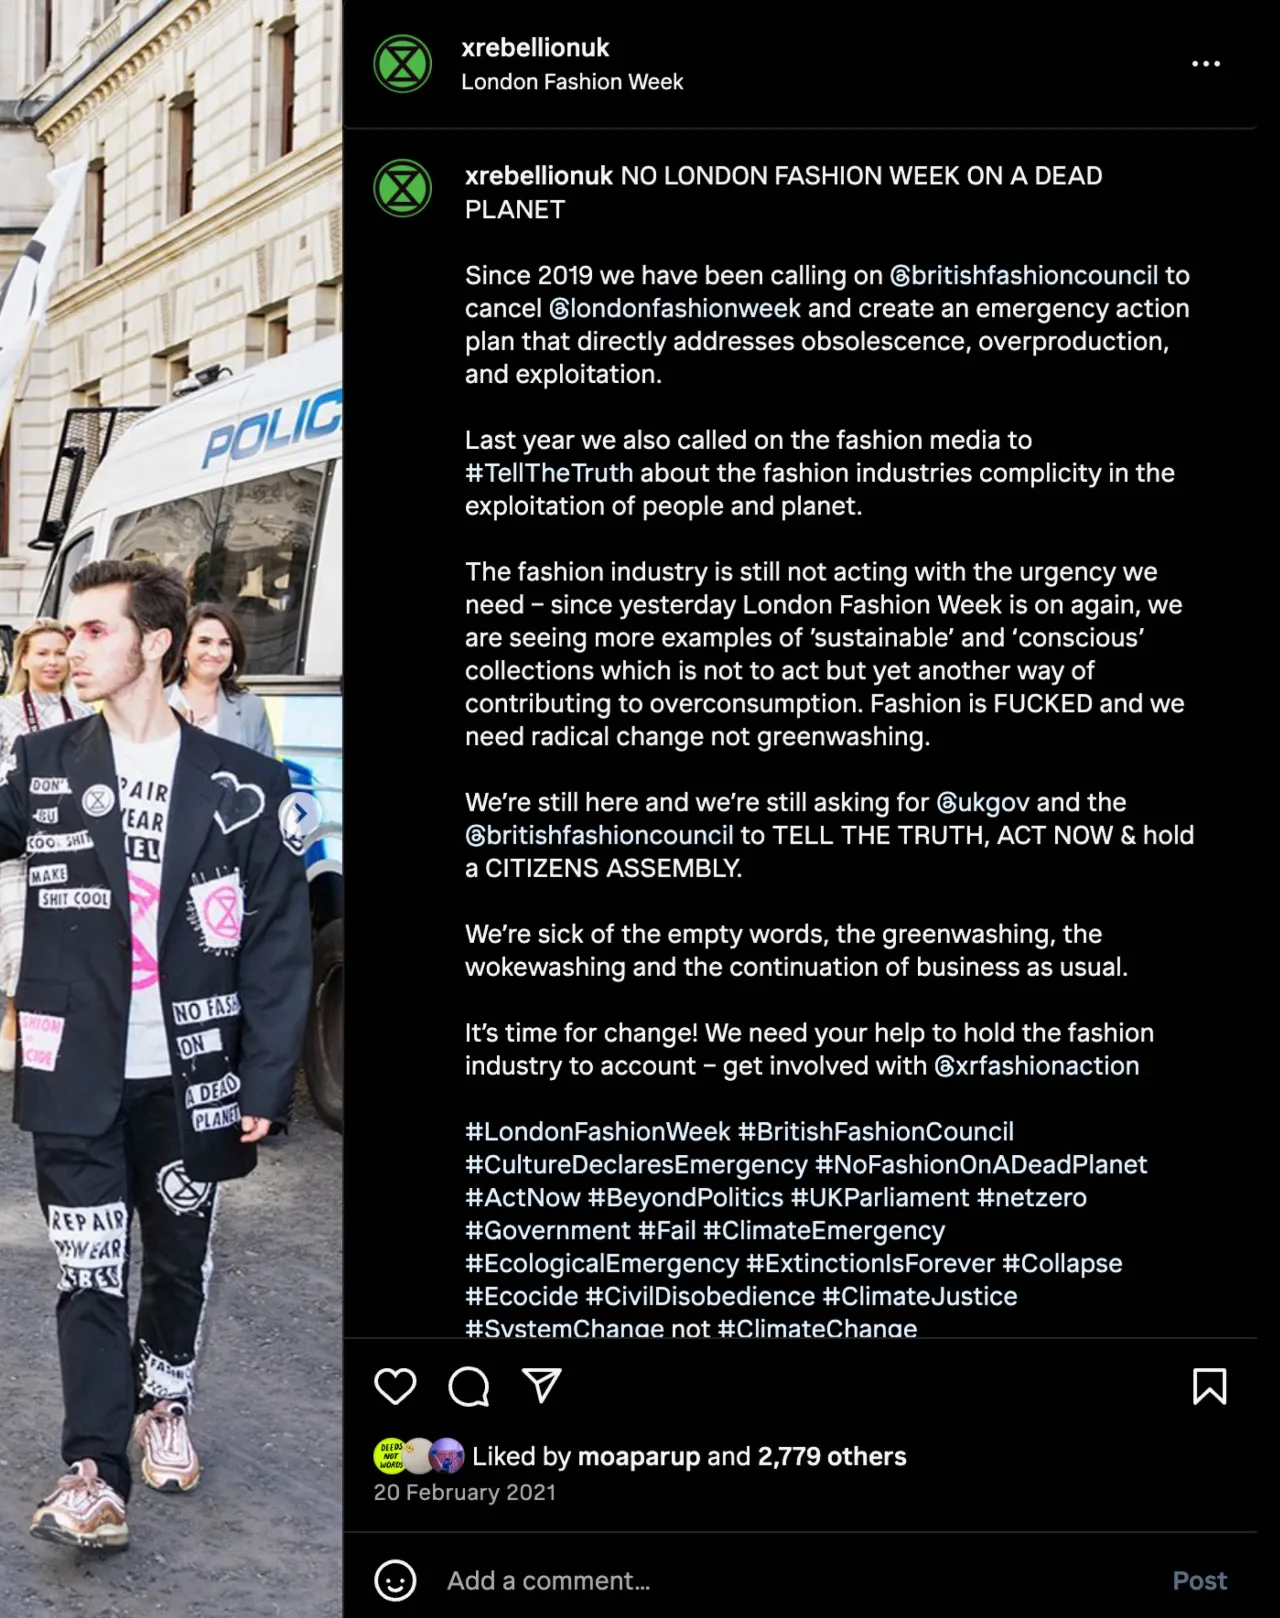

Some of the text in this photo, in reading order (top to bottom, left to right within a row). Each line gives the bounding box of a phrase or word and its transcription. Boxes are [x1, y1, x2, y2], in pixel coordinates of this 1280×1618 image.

[31, 867, 66, 884] MAKE
[42, 891, 109, 906] SHIT COOL
[175, 1000, 201, 1022] NO
[180, 1035, 205, 1056] ON
[200, 1076, 237, 1101] DEAD
[195, 1105, 239, 1129] PLANET
[52, 1208, 124, 1232] REPAIR
